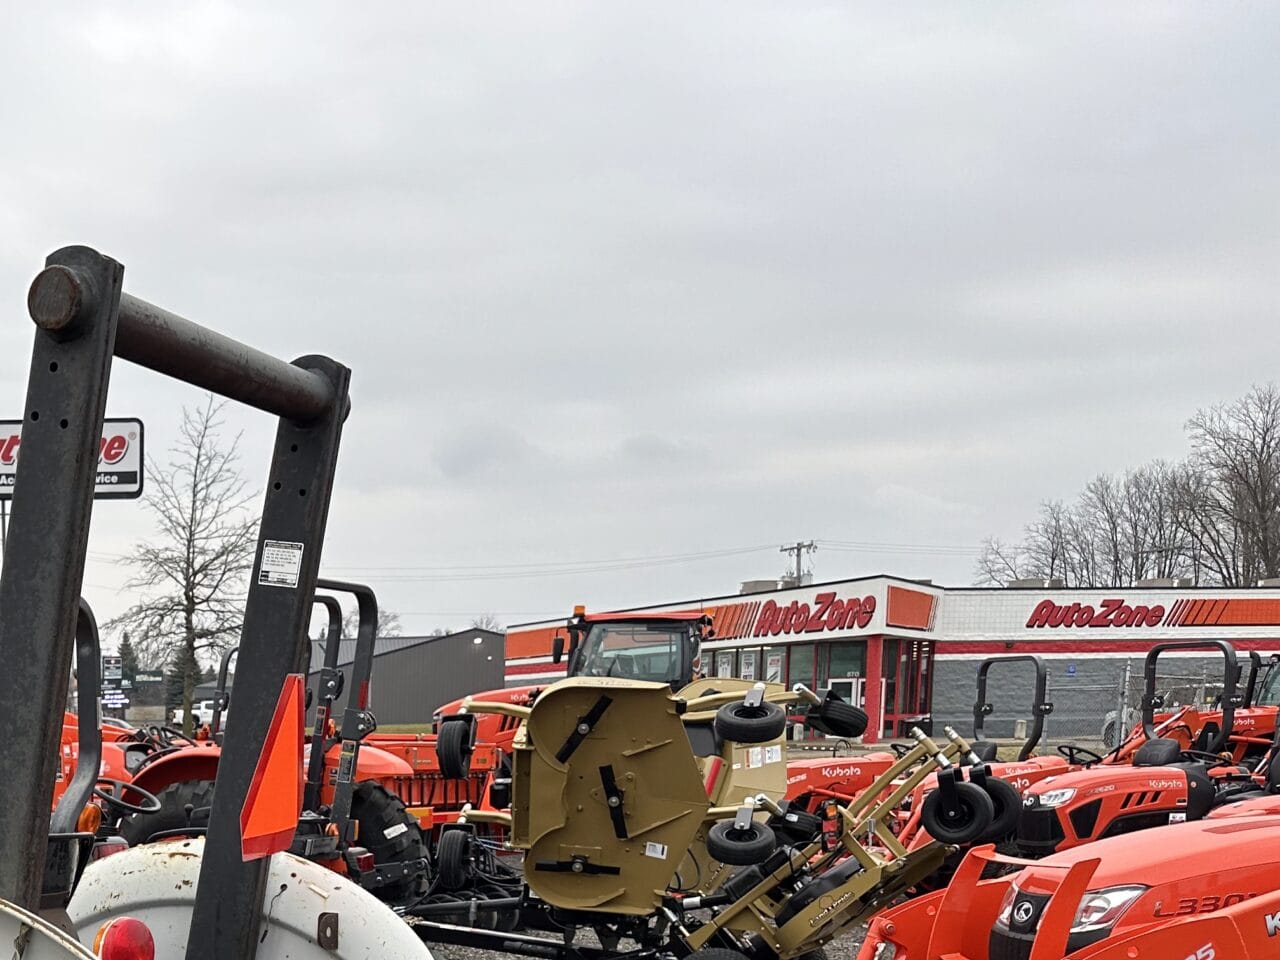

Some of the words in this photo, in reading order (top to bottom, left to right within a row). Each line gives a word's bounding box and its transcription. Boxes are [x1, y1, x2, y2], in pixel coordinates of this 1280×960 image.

[753, 592, 877, 637] AutoZone
[1026, 599, 1165, 628] AutoZone
[822, 766, 861, 777] Kubota
[1149, 779, 1183, 788] Kubota
[1153, 892, 1257, 918] L330
